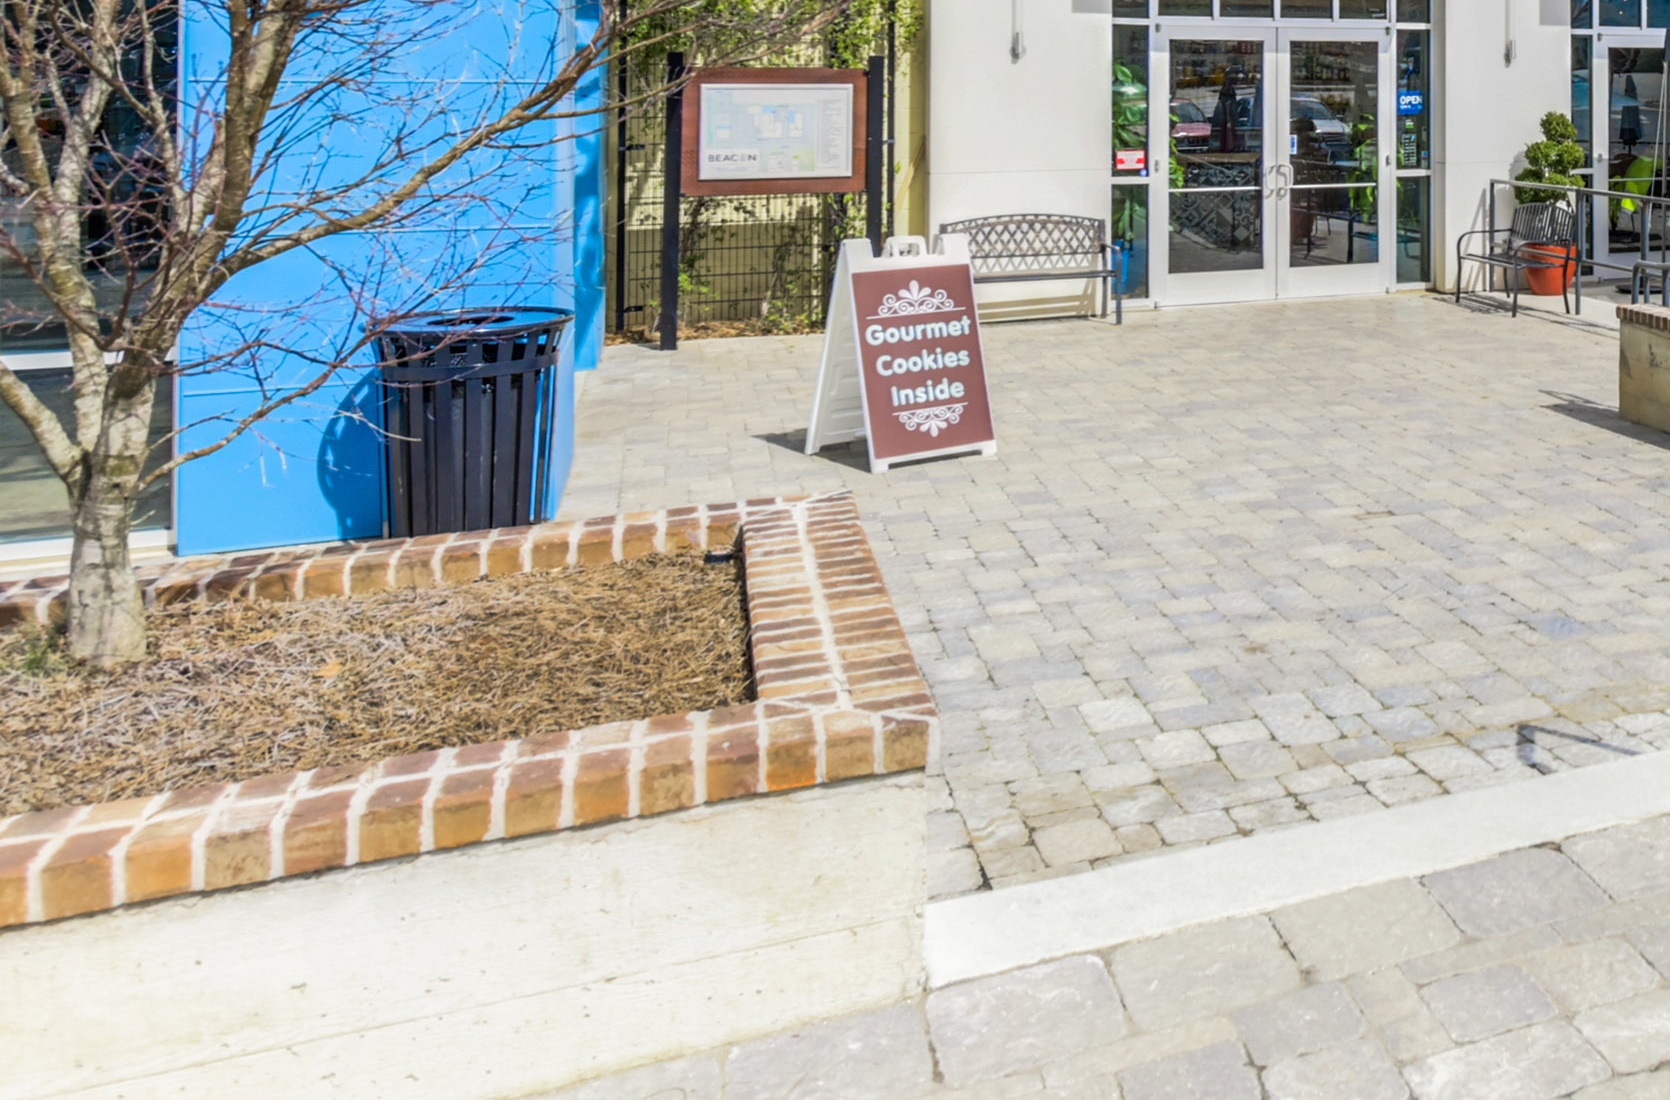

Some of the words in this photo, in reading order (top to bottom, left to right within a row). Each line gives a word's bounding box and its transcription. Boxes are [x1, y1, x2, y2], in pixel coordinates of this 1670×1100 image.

[1400, 95, 1423, 105] OPEN
[865, 315, 971, 345] Gourmet
[876, 347, 970, 376] Cookies
[891, 377, 965, 406] Inside
